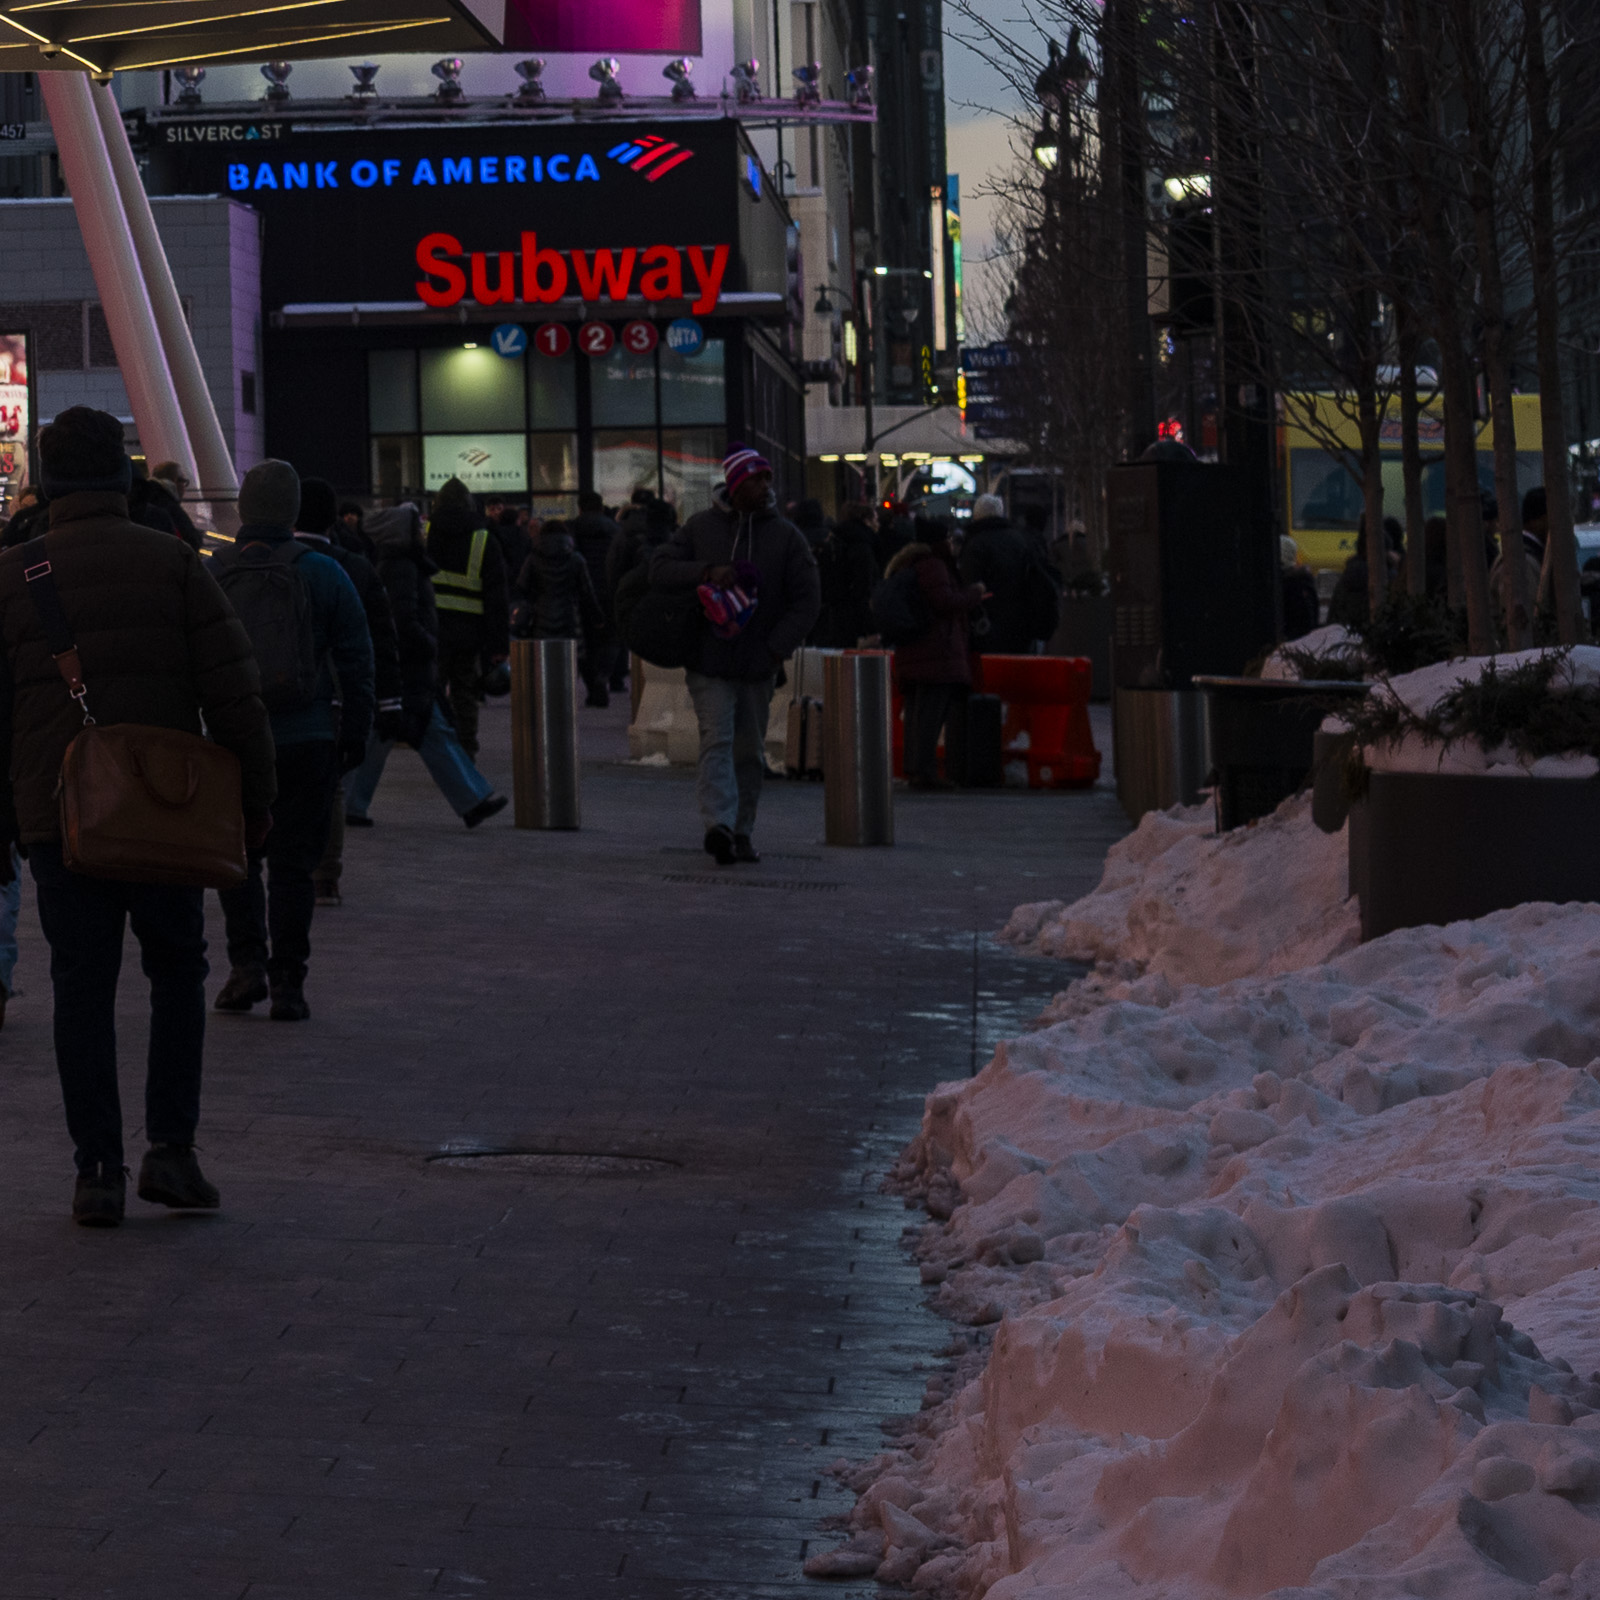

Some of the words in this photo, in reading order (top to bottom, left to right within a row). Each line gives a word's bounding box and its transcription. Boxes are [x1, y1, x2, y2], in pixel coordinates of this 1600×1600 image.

[228, 160, 341, 191] BANK
[350, 159, 402, 189] OF
[412, 152, 601, 186] AMERICA
[414, 230, 731, 316] Subway
[545, 328, 558, 351] 1
[588, 326, 606, 350] 2
[630, 325, 649, 349] 3
[476, 470, 521, 480] AMERICA
